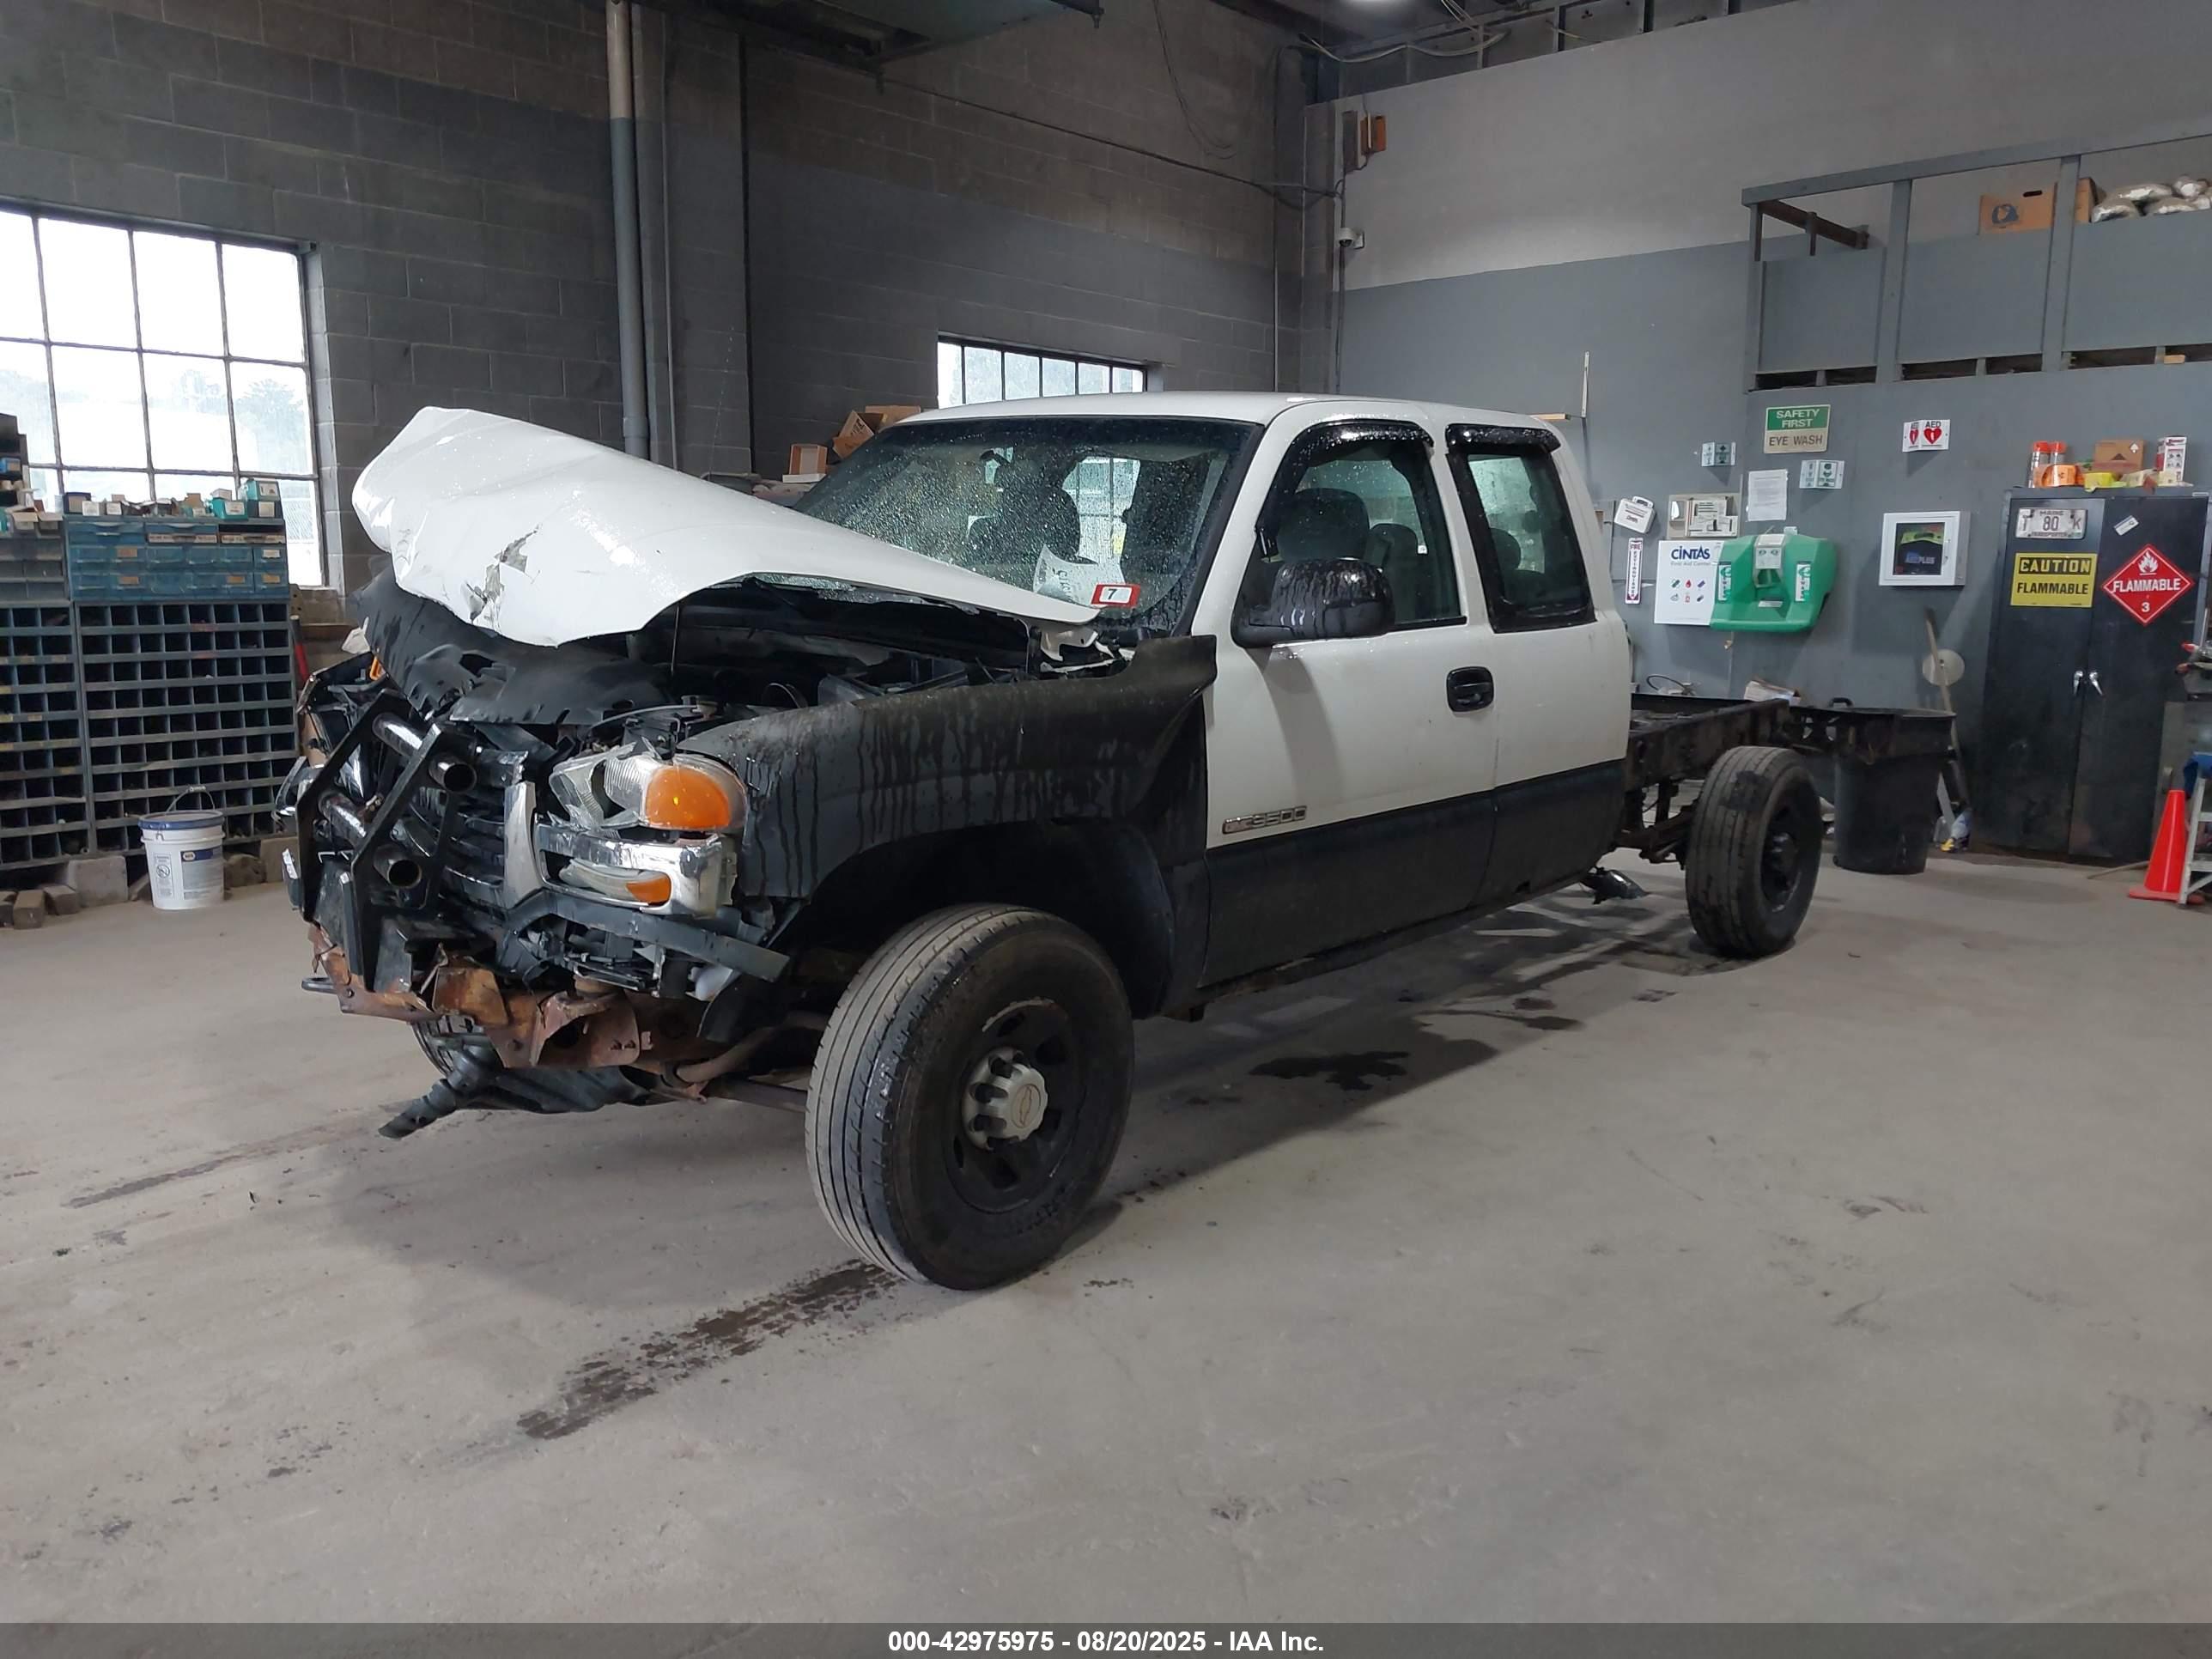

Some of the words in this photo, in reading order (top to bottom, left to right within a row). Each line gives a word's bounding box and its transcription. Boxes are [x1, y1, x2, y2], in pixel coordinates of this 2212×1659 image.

[1776, 409, 1820, 419] SAFETY
[1782, 418, 1813, 428] FIRST
[1769, 436, 1788, 446] EYE
[1793, 434, 1822, 446] WASH
[2043, 516, 2059, 531] 80
[2073, 517, 2081, 530] K
[1671, 545, 1711, 560] CINTAS
[2020, 559, 2090, 573] CAUTION
[2016, 582, 2088, 594] FLAMMABLE
[2113, 578, 2181, 592] FLAMMABLE
[1108, 588, 1118, 600] 7
[2141, 602, 2150, 612] 3
